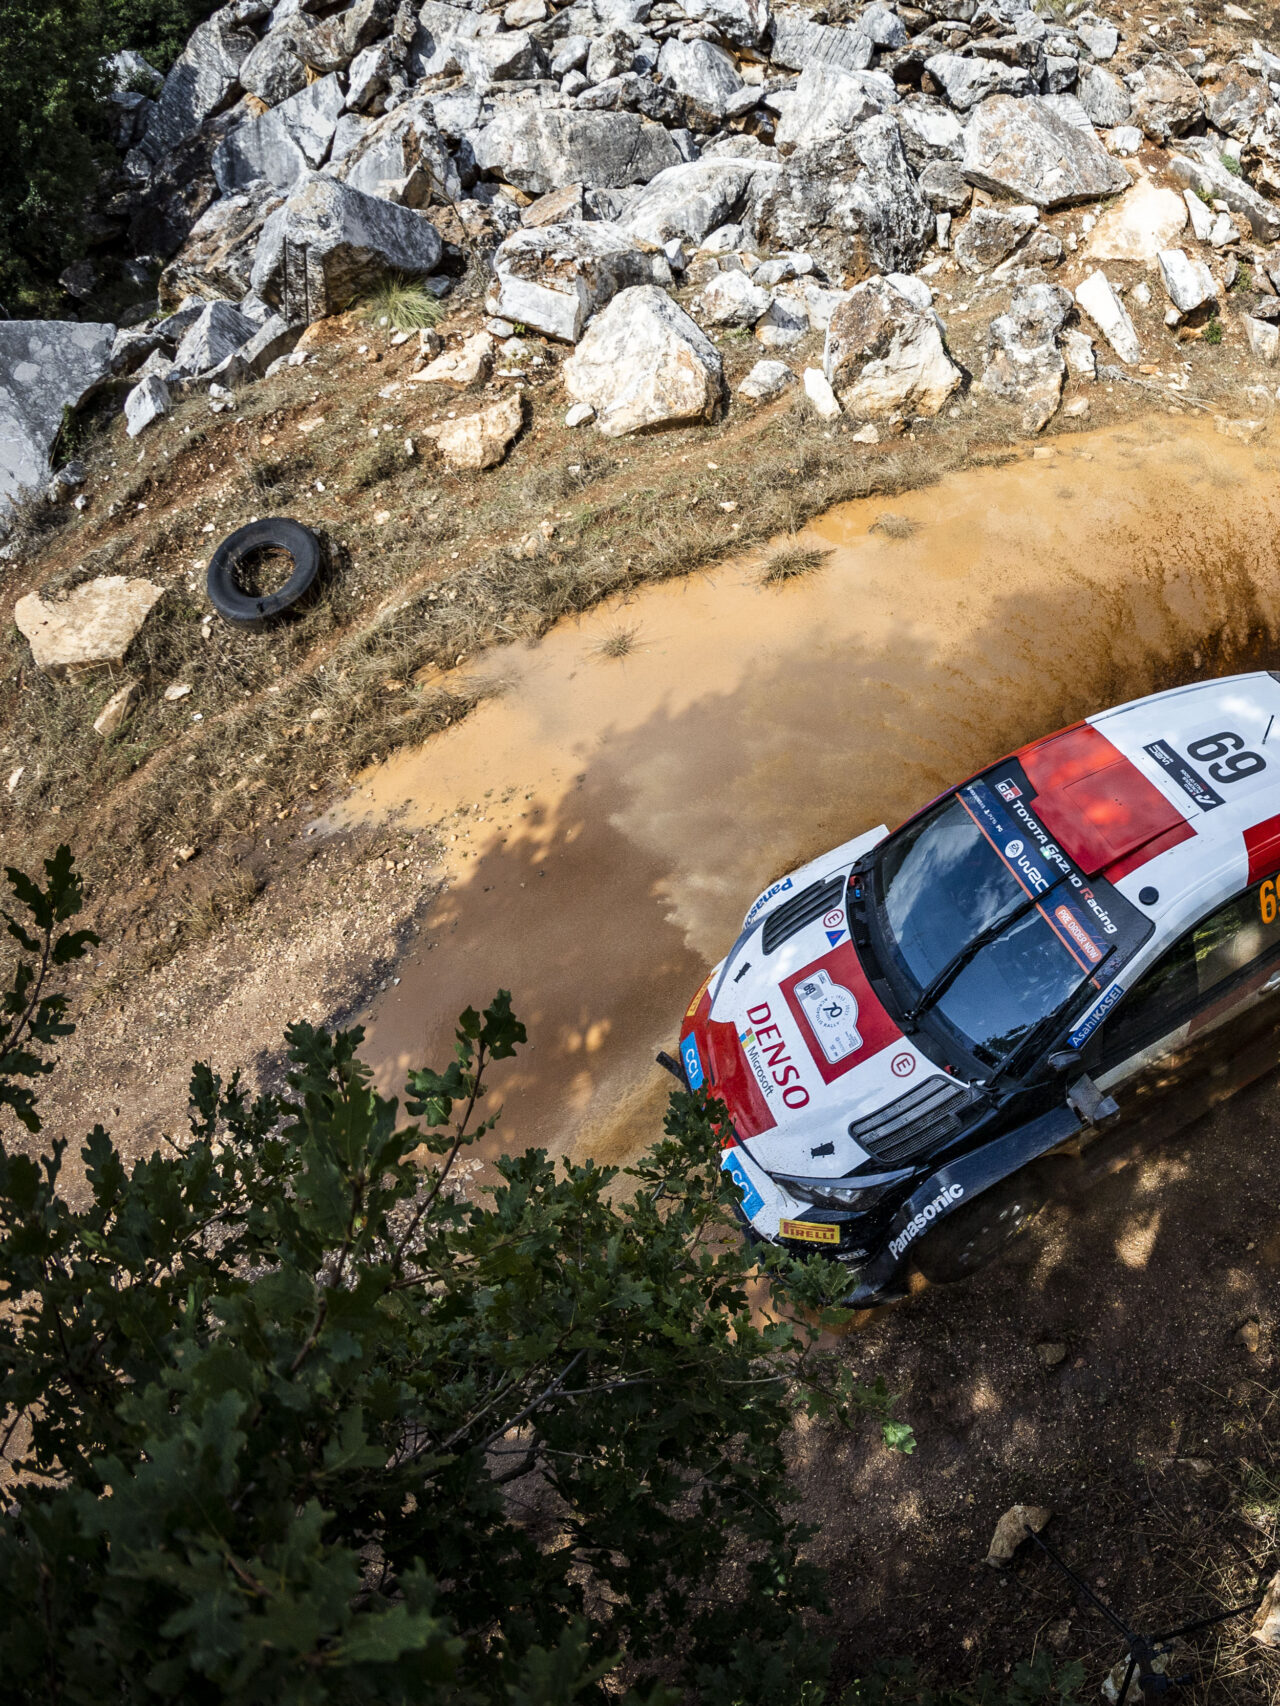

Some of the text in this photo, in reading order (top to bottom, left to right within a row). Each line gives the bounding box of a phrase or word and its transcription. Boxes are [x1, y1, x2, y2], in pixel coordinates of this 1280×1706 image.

[1187, 732, 1266, 783] 69
[998, 782, 1015, 802] GR
[1012, 800, 1048, 845] TOYOTA
[1080, 887, 1118, 934] Racing
[1018, 854, 1050, 893] WRC
[1058, 909, 1098, 959] PRE ORDER NOW
[803, 983, 816, 996] 69
[686, 1048, 699, 1079] CCI
[746, 1002, 810, 1109] DENSO
[748, 1046, 775, 1097] Microsoft
[783, 1221, 835, 1240] PIRELLI
[888, 1183, 964, 1260] Panasonic
